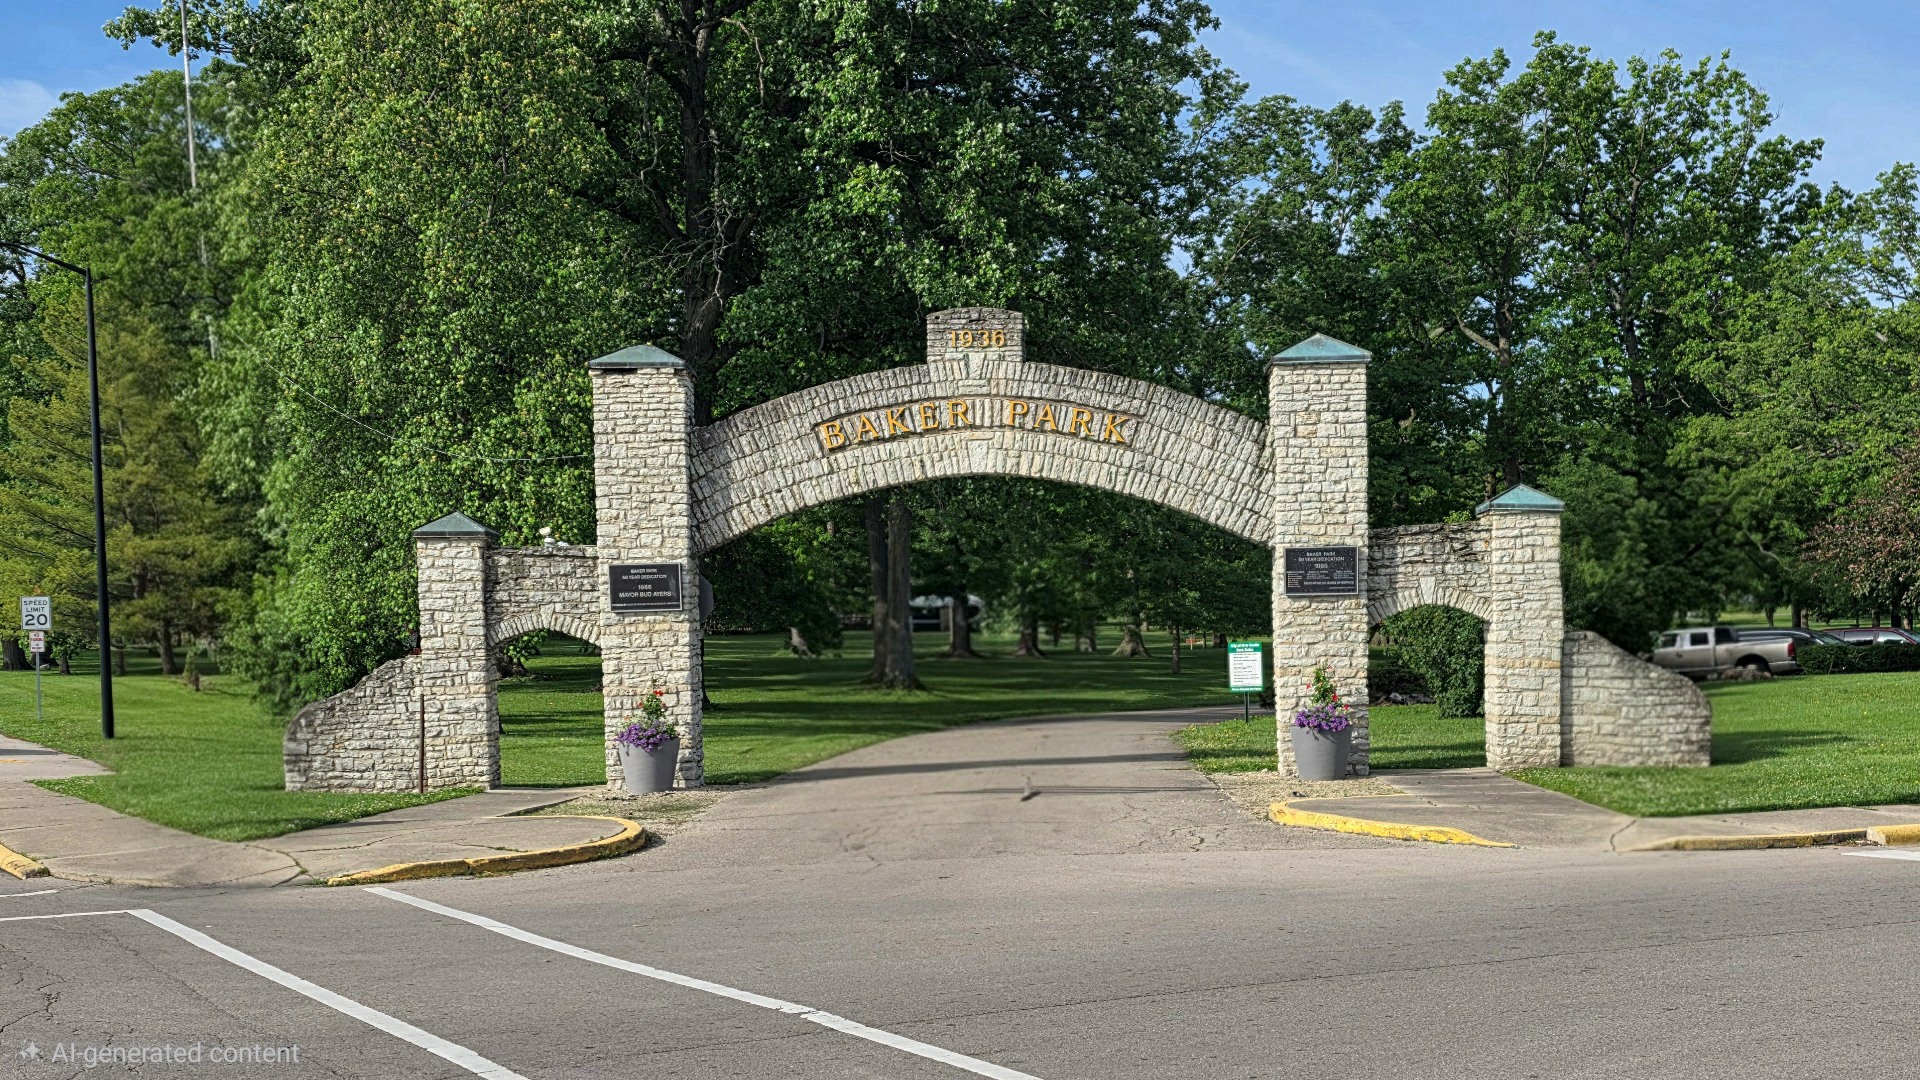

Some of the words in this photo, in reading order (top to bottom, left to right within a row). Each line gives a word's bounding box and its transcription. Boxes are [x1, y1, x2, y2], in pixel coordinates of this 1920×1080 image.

[950, 329, 1006, 348] 1936
[820, 400, 973, 451] BAKER
[1007, 400, 1131, 444] PARK
[24, 613, 48, 626] 20
